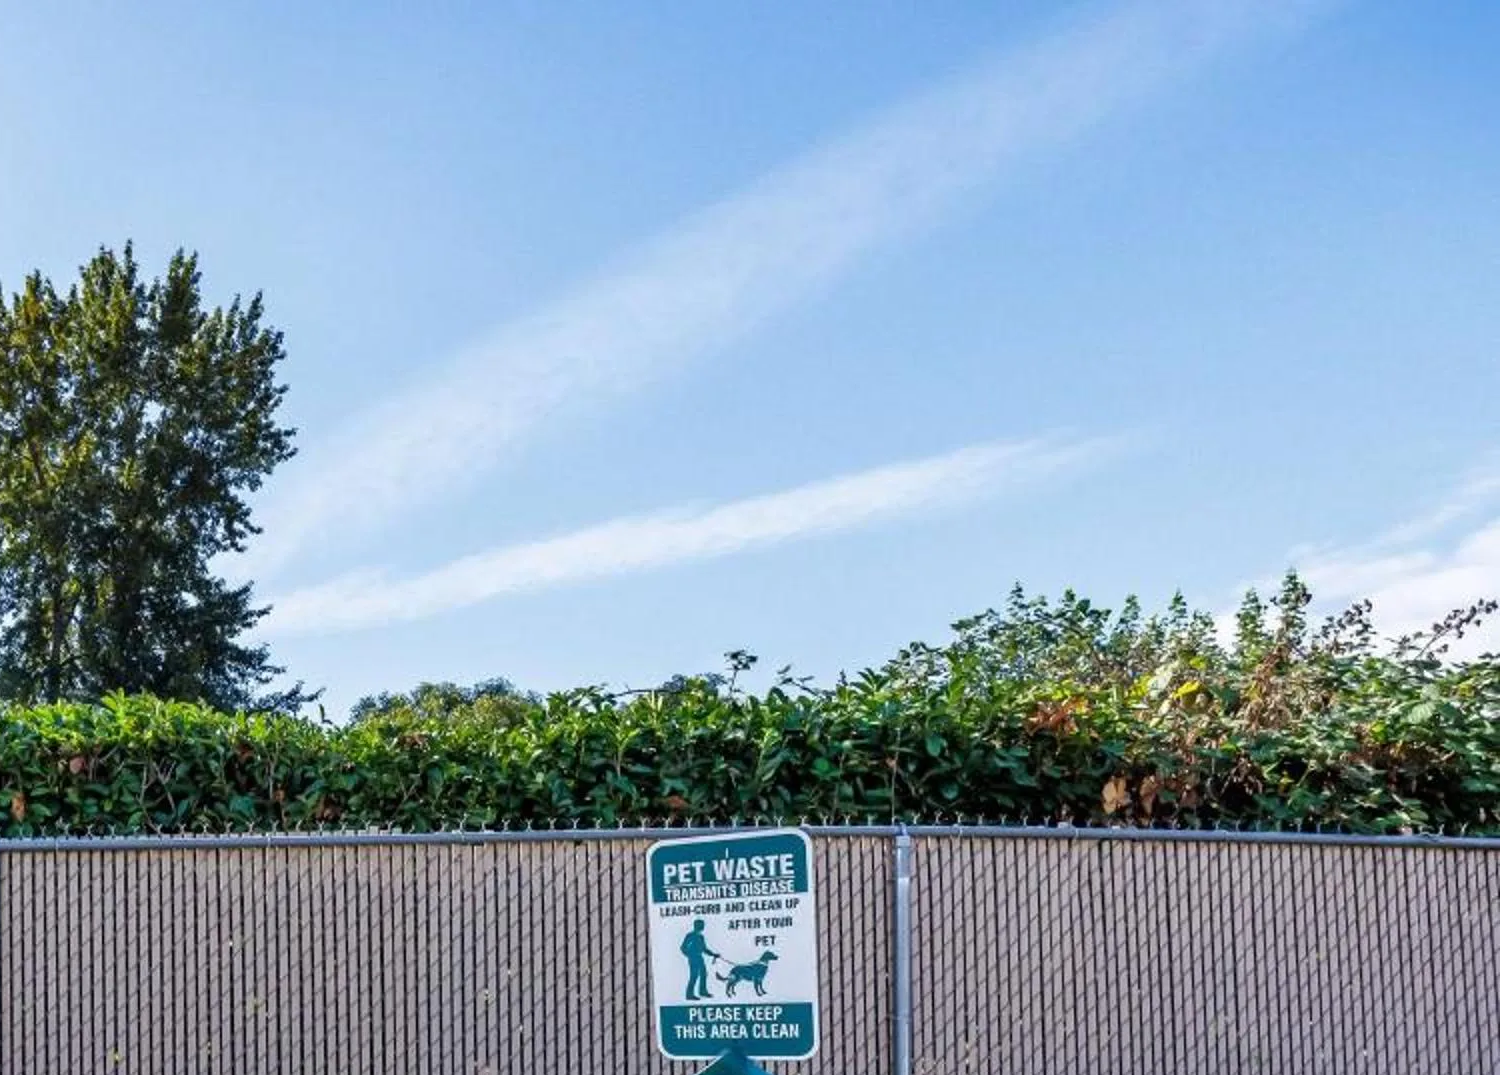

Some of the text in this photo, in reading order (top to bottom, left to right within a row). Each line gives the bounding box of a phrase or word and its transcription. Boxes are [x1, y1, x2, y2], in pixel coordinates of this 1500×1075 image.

[663, 853, 794, 884] PET WASTE
[665, 880, 794, 901] TRANSMITS DISEASE
[660, 898, 799, 917] LEASH-CURB AND CLEAN UP
[728, 917, 793, 930] AFTER YOUR
[755, 936, 775, 946] PET
[689, 1006, 782, 1022] PLEASE KEEP
[674, 1023, 799, 1039] THIS AREA CLEAN
